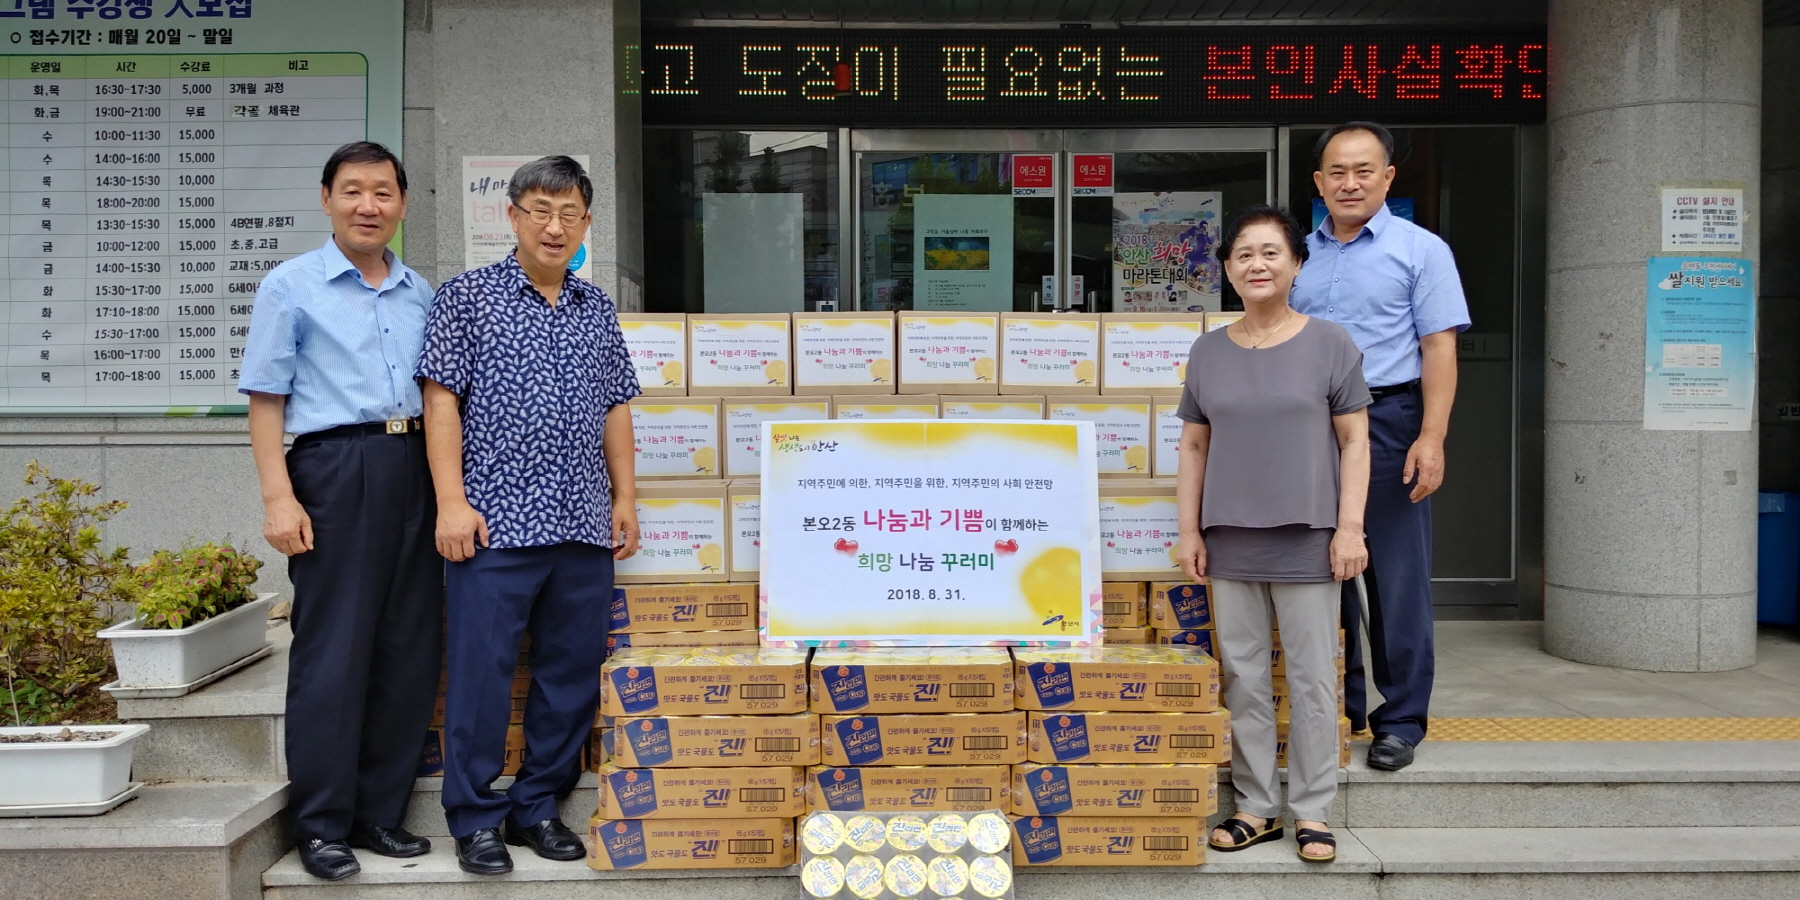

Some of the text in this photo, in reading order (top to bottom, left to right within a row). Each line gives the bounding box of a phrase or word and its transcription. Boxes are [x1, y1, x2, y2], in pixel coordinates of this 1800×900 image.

[30, 29, 232, 45] 접수기간 매월 20일 말일
[30, 61, 61, 73] 운영일
[116, 61, 136, 73] 시간
[180, 61, 210, 72] 수강료
[289, 60, 309, 71] 비고
[942, 46, 1164, 100] 필요없는
[33, 84, 60, 96] 화,목
[95, 84, 161, 95] 16:30~17:30
[182, 84, 211, 94] 5,000
[229, 82, 284, 94] 3개월 과정
[33, 106, 60, 118] 화,금
[95, 106, 161, 118] 19:00~21:00
[186, 106, 205, 118] 무료
[268, 105, 300, 117] 체육관
[43, 131, 52, 142] 수
[95, 129, 160, 141] 10:00~11:30
[178, 129, 215, 141] 15,000
[43, 154, 52, 165] 수
[95, 153, 160, 165] 14:00~16:00
[179, 152, 215, 164] 15,000
[1020, 166, 1046, 176] 에스원
[1080, 165, 1105, 175] 에스원
[43, 176, 51, 187] 목
[96, 175, 160, 187] 14:30~15:30
[178, 175, 214, 186] 10,000
[470, 177, 509, 196] 내 마
[42, 198, 51, 209] 목
[96, 197, 160, 209] 18:00~20:00
[178, 196, 214, 208] 15,000
[1677, 197, 1734, 206] CCTV 설치 안내
[42, 219, 51, 231] 목
[96, 219, 160, 230] 13:30~15:30
[178, 219, 215, 230] 15,000
[230, 238, 278, 251] 초,중,고급
[1125, 235, 1148, 244] 2018
[43, 241, 52, 252] 금
[96, 240, 160, 252] 10:00~12:00
[179, 240, 216, 252] 15,000
[1123, 241, 1192, 265] 안산 희망
[43, 263, 53, 275] 금
[96, 262, 160, 274] 14:00~15:30
[180, 262, 215, 273] 10,000
[1123, 268, 1188, 284] 마라톤대회
[1669, 270, 1705, 288] 쌀지원
[43, 284, 53, 297] 화
[95, 284, 161, 296] 15:30~17:00
[179, 284, 213, 295] 15,000
[228, 282, 260, 295] 6세이
[42, 306, 51, 319] 화
[96, 306, 160, 318] 17:10~18:00
[177, 305, 215, 317] 15,000
[42, 328, 52, 341] 수
[94, 328, 159, 339] 15:30~17:00
[178, 327, 215, 338] 15,000
[41, 350, 50, 361] 목
[94, 348, 160, 360] 16:00~17:00
[179, 347, 215, 359] 15,000
[719, 349, 741, 357] 나눔과
[41, 371, 51, 383] 목
[96, 370, 160, 382] 17:00~18:00
[179, 369, 215, 381] 15,000
[812, 441, 838, 452] 안산
[798, 478, 1053, 490] 지역주민에 의한, 지역주민을 위한, 지역주민의 사회 안전망
[802, 516, 855, 532] 본오2동
[863, 508, 932, 532] 나눔과
[1001, 518, 1049, 532] 함께하는
[857, 552, 994, 572] 희망 나눔 꾸러미
[887, 589, 965, 600] 2018. 8. 31.
[664, 675, 687, 683] 간편하게
[621, 677, 653, 697] 진라면
[663, 695, 678, 703] 맛도
[679, 695, 700, 703] 국물도
[1038, 672, 1070, 691] 진라면
[1079, 691, 1093, 699] 맛도
[1095, 691, 1116, 699] 국물도
[1054, 686, 1071, 695] Cup
[638, 692, 655, 701] Cup
